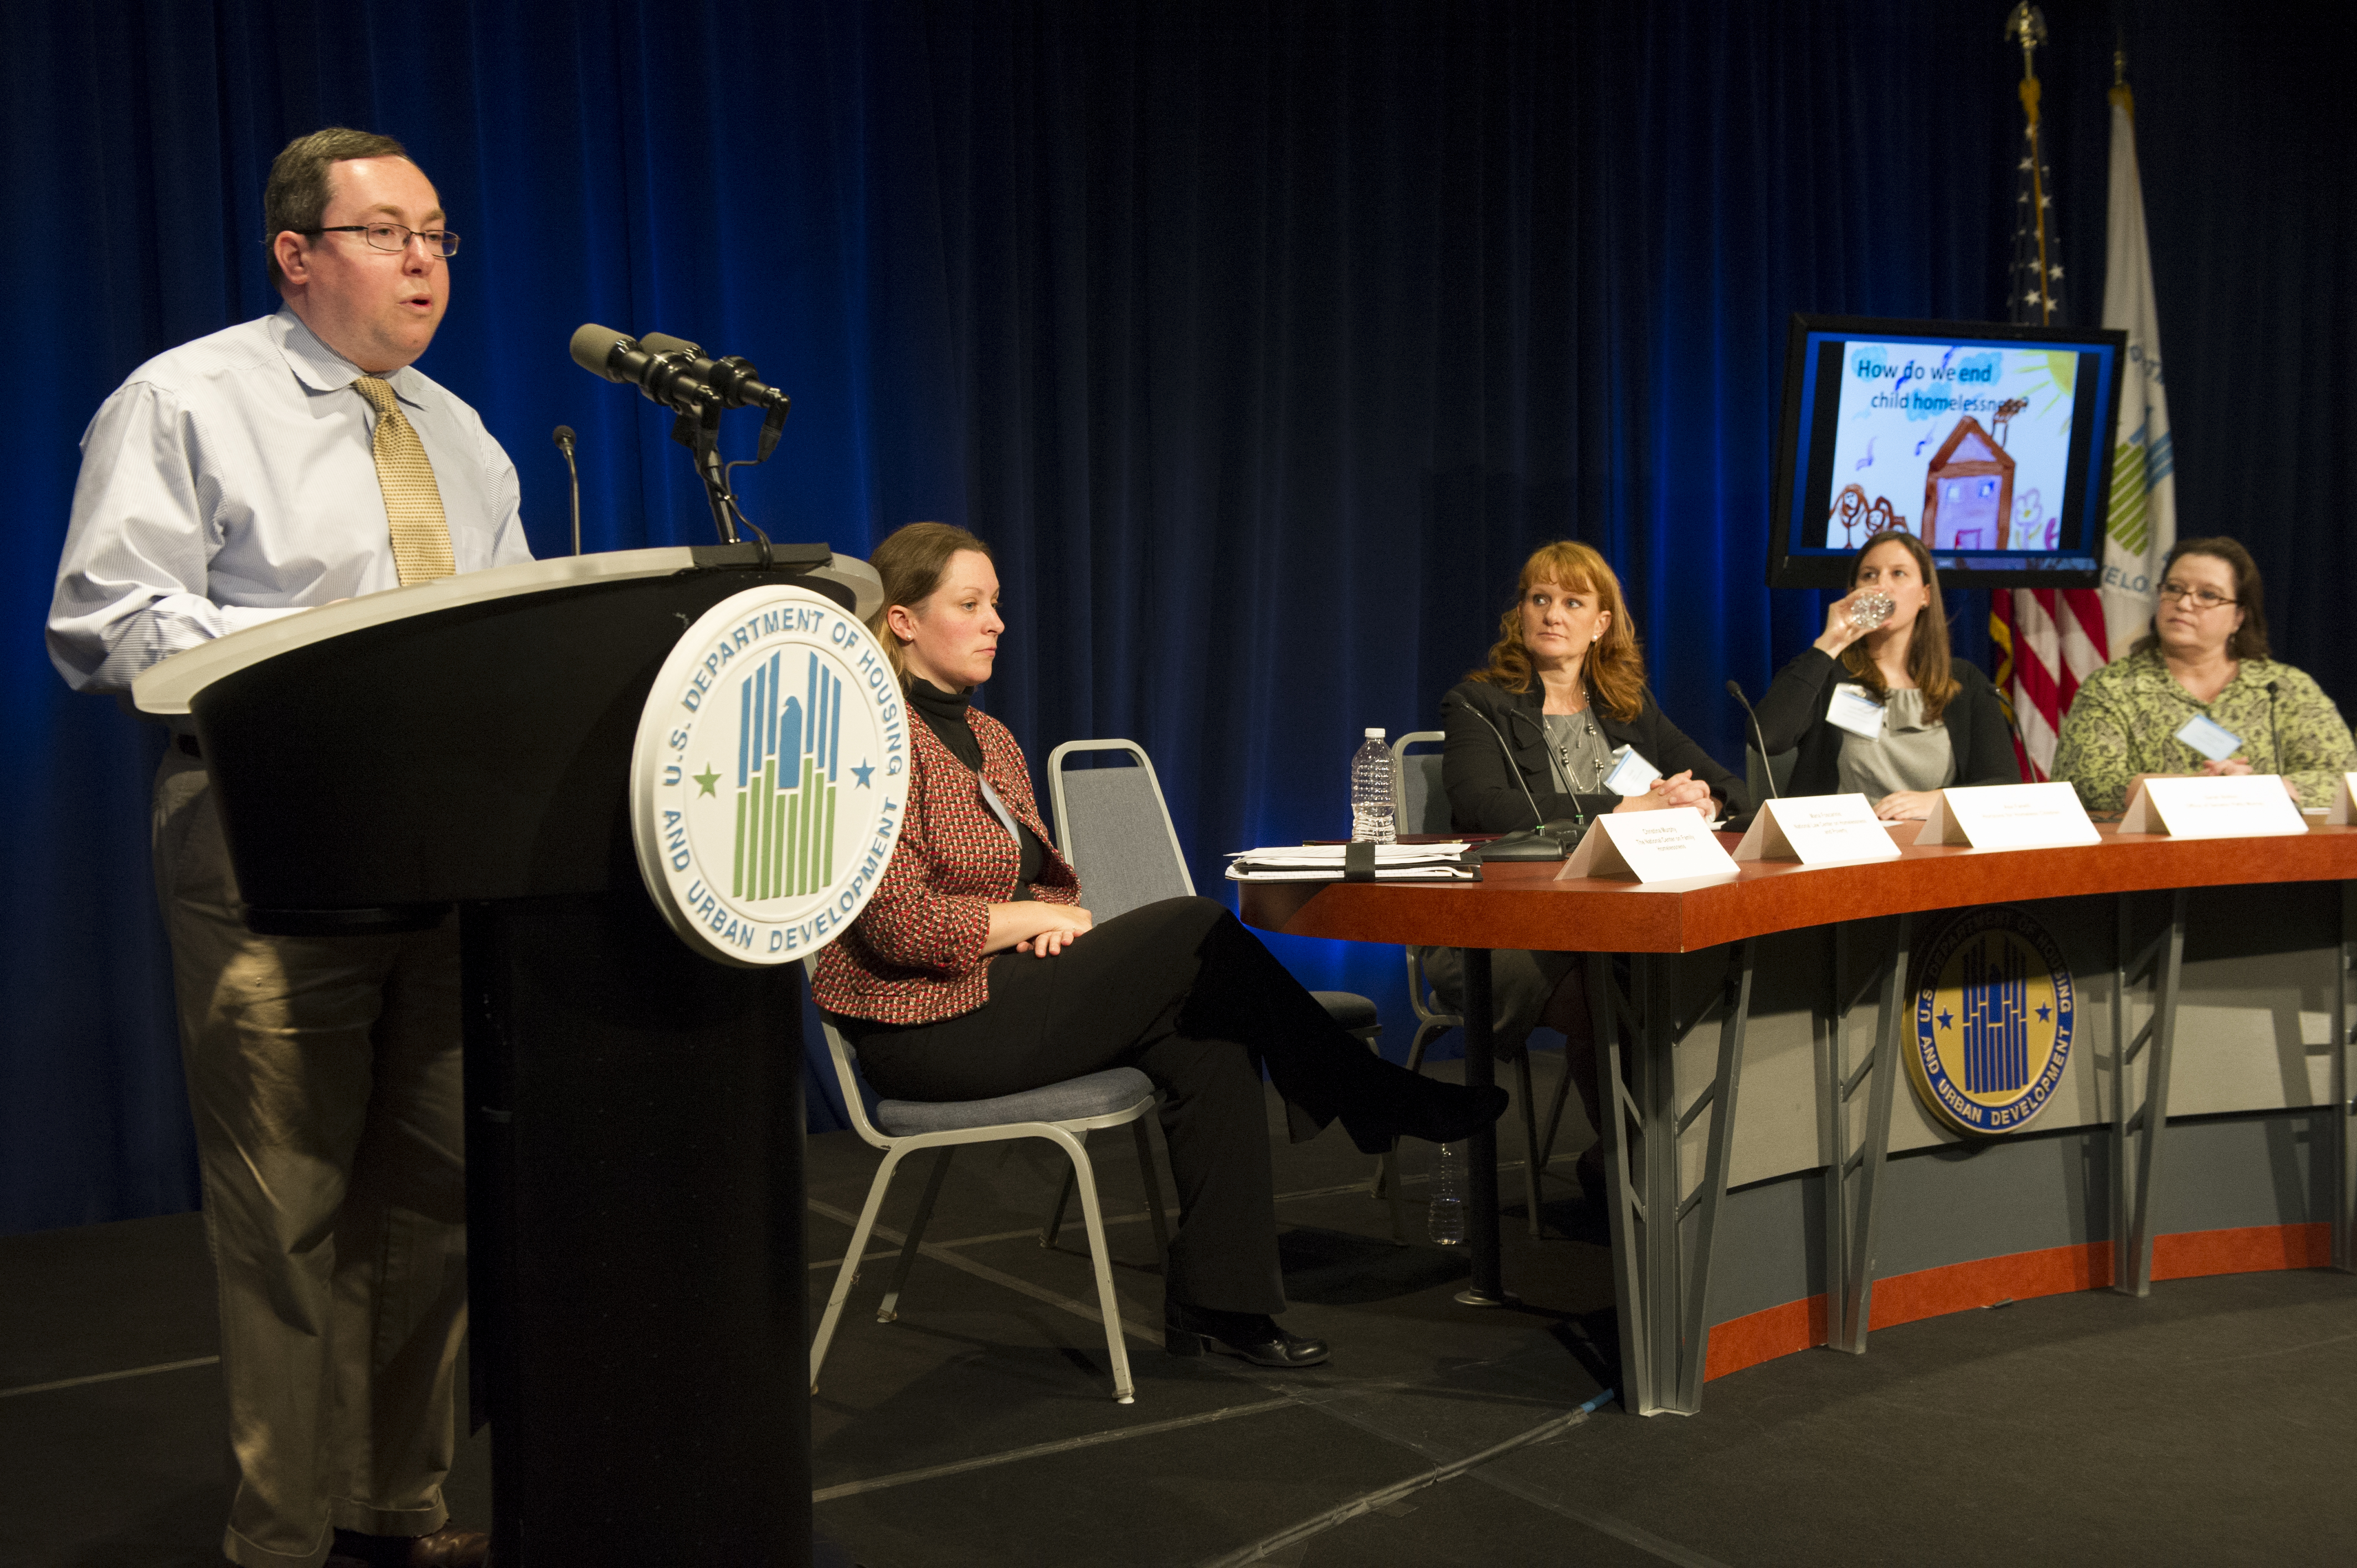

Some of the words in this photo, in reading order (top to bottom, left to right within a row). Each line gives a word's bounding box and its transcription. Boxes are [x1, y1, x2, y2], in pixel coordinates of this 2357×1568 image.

[1857, 359, 1898, 379] How
[1903, 360, 1925, 380] do
[1931, 365, 1955, 381] we
[1959, 363, 1993, 382] end
[1871, 390, 1909, 409] child
[663, 723, 691, 786] U.S.
[683, 608, 825, 713] DEPARTMENT
[832, 621, 859, 651] OF
[857, 649, 903, 776] HOUSING
[663, 809, 691, 873] AND
[687, 880, 755, 950] URBAN
[769, 796, 898, 953] DEVELOPMENT
[1920, 1036, 1939, 1075] AND
[1938, 1079, 1983, 1123] URBAN
[1990, 1025, 2071, 1127] DEVELOPMENT
